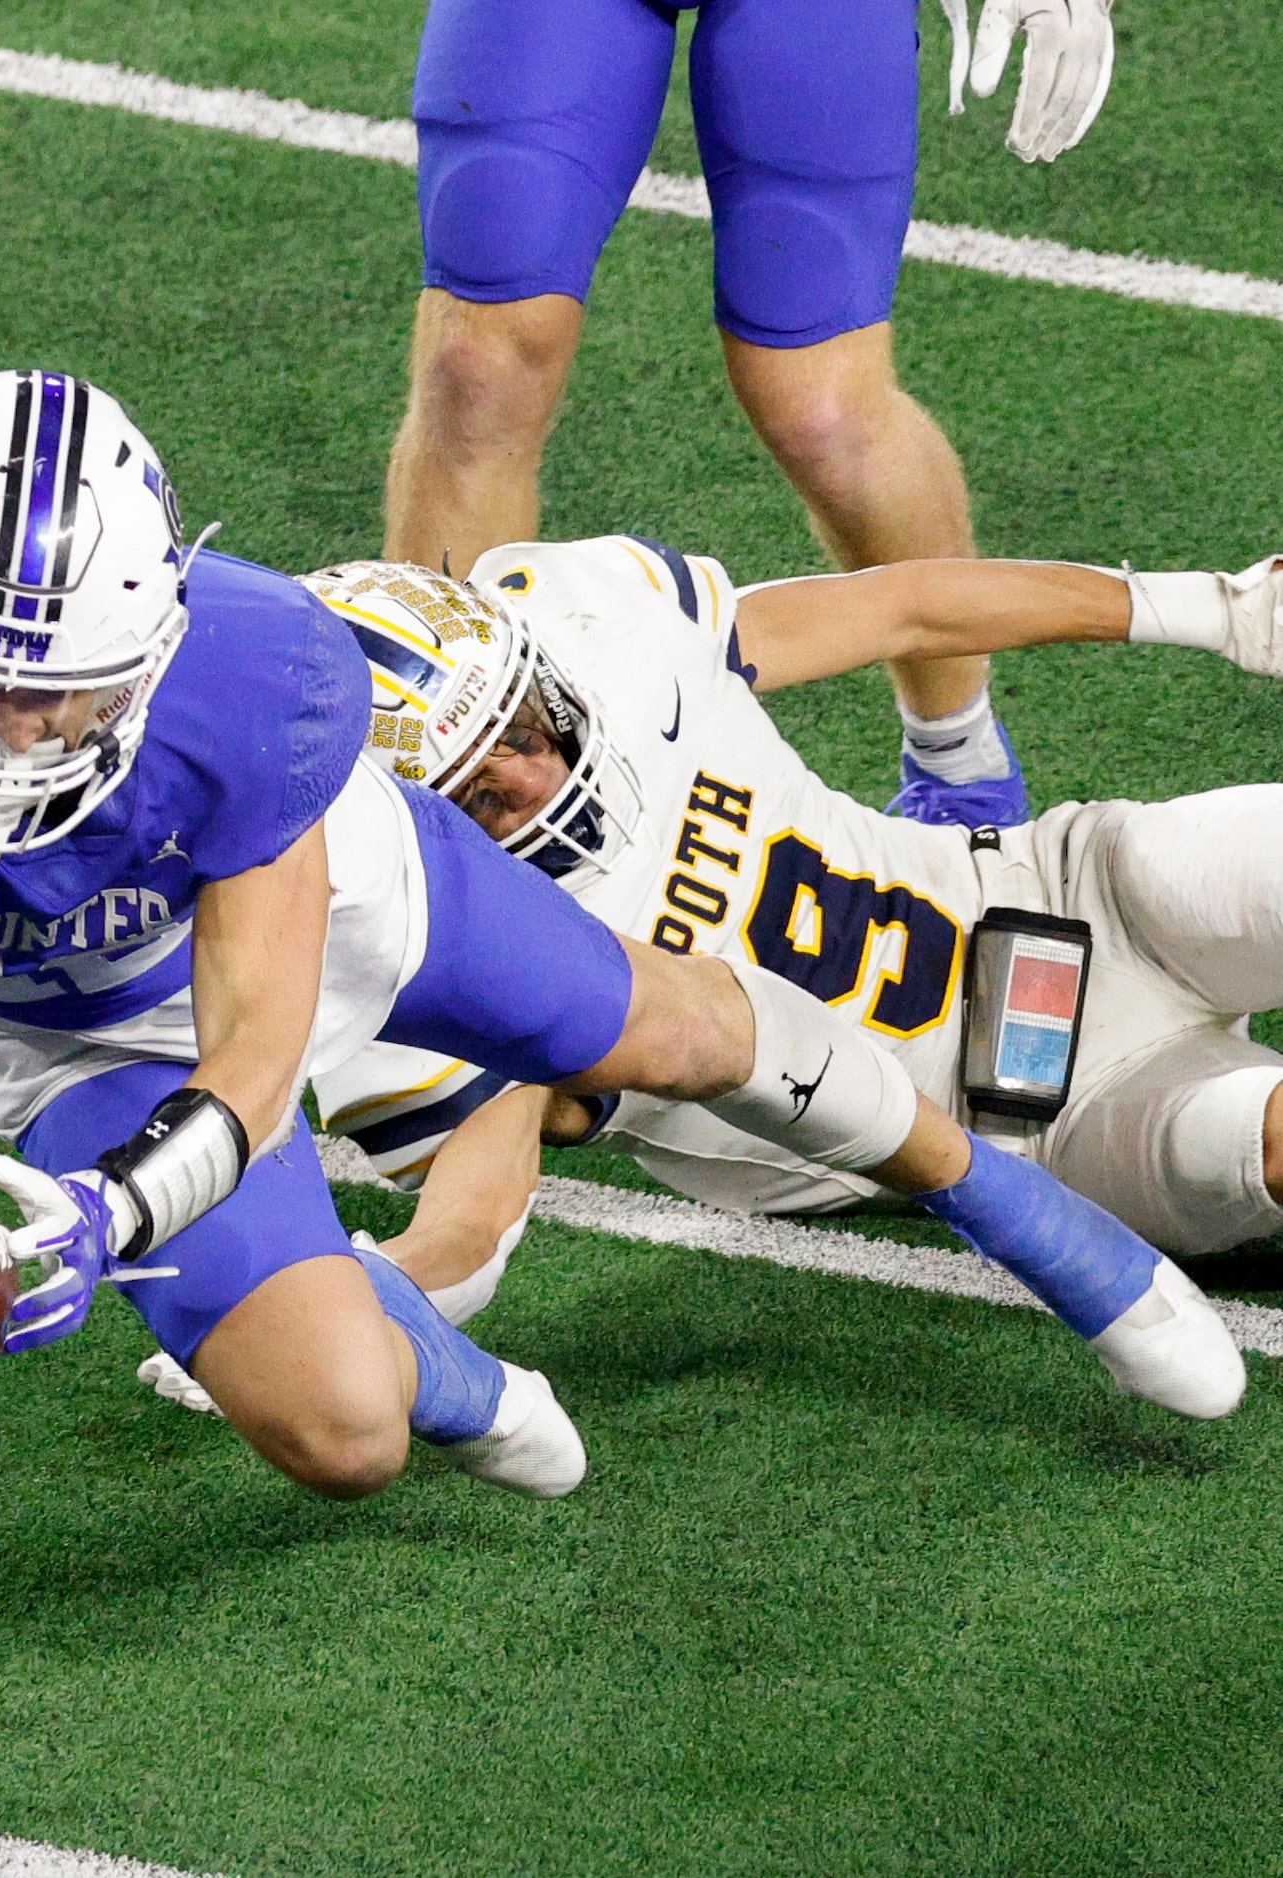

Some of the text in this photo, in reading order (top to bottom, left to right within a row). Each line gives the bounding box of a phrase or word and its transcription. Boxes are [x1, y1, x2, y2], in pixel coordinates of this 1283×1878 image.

[435, 618, 468, 643] 212
[372, 713, 398, 749] 212
[398, 717, 424, 753] 212
[739, 826, 965, 1041] 9
